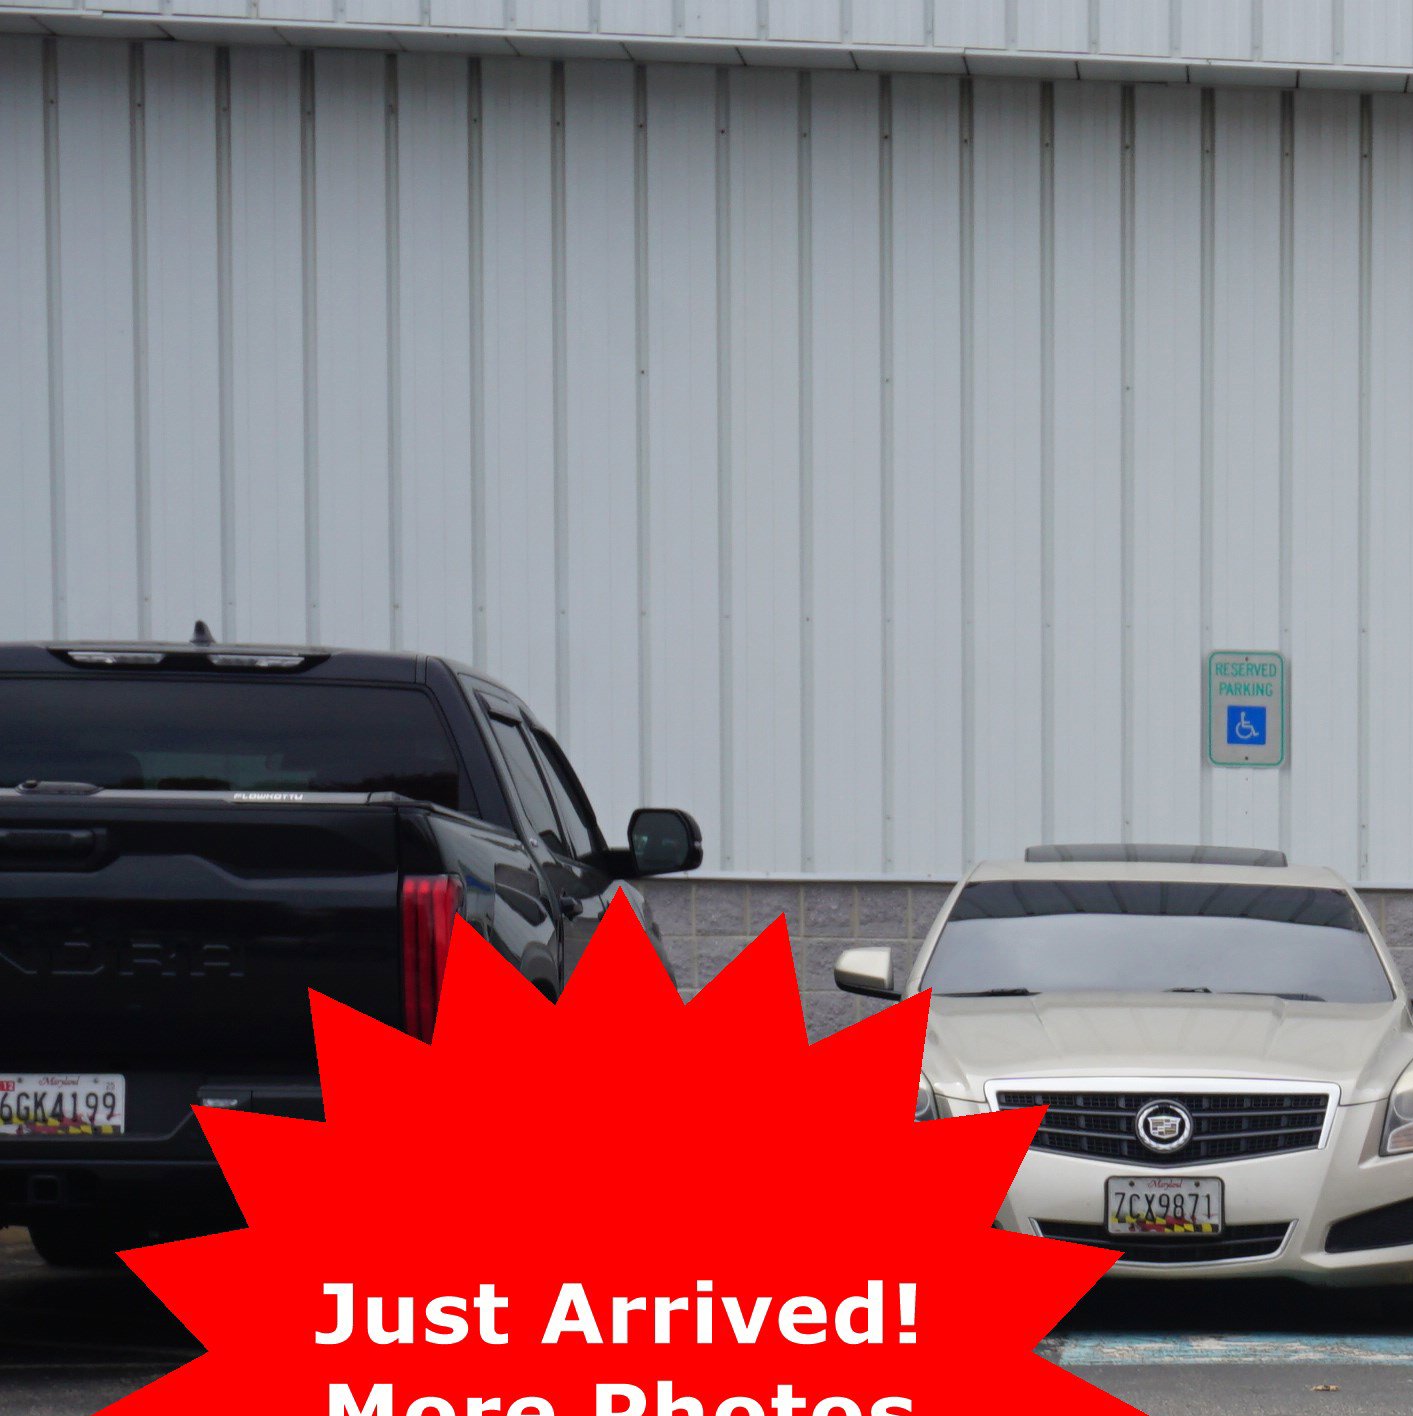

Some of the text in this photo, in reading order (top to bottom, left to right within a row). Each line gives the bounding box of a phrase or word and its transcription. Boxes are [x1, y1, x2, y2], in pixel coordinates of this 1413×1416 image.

[1215, 663, 1277, 677] RESERVED
[1219, 682, 1273, 696] PARKING
[0, 1092, 116, 1122] 6GK4199
[1114, 1192, 1211, 1222] 7CX9871
